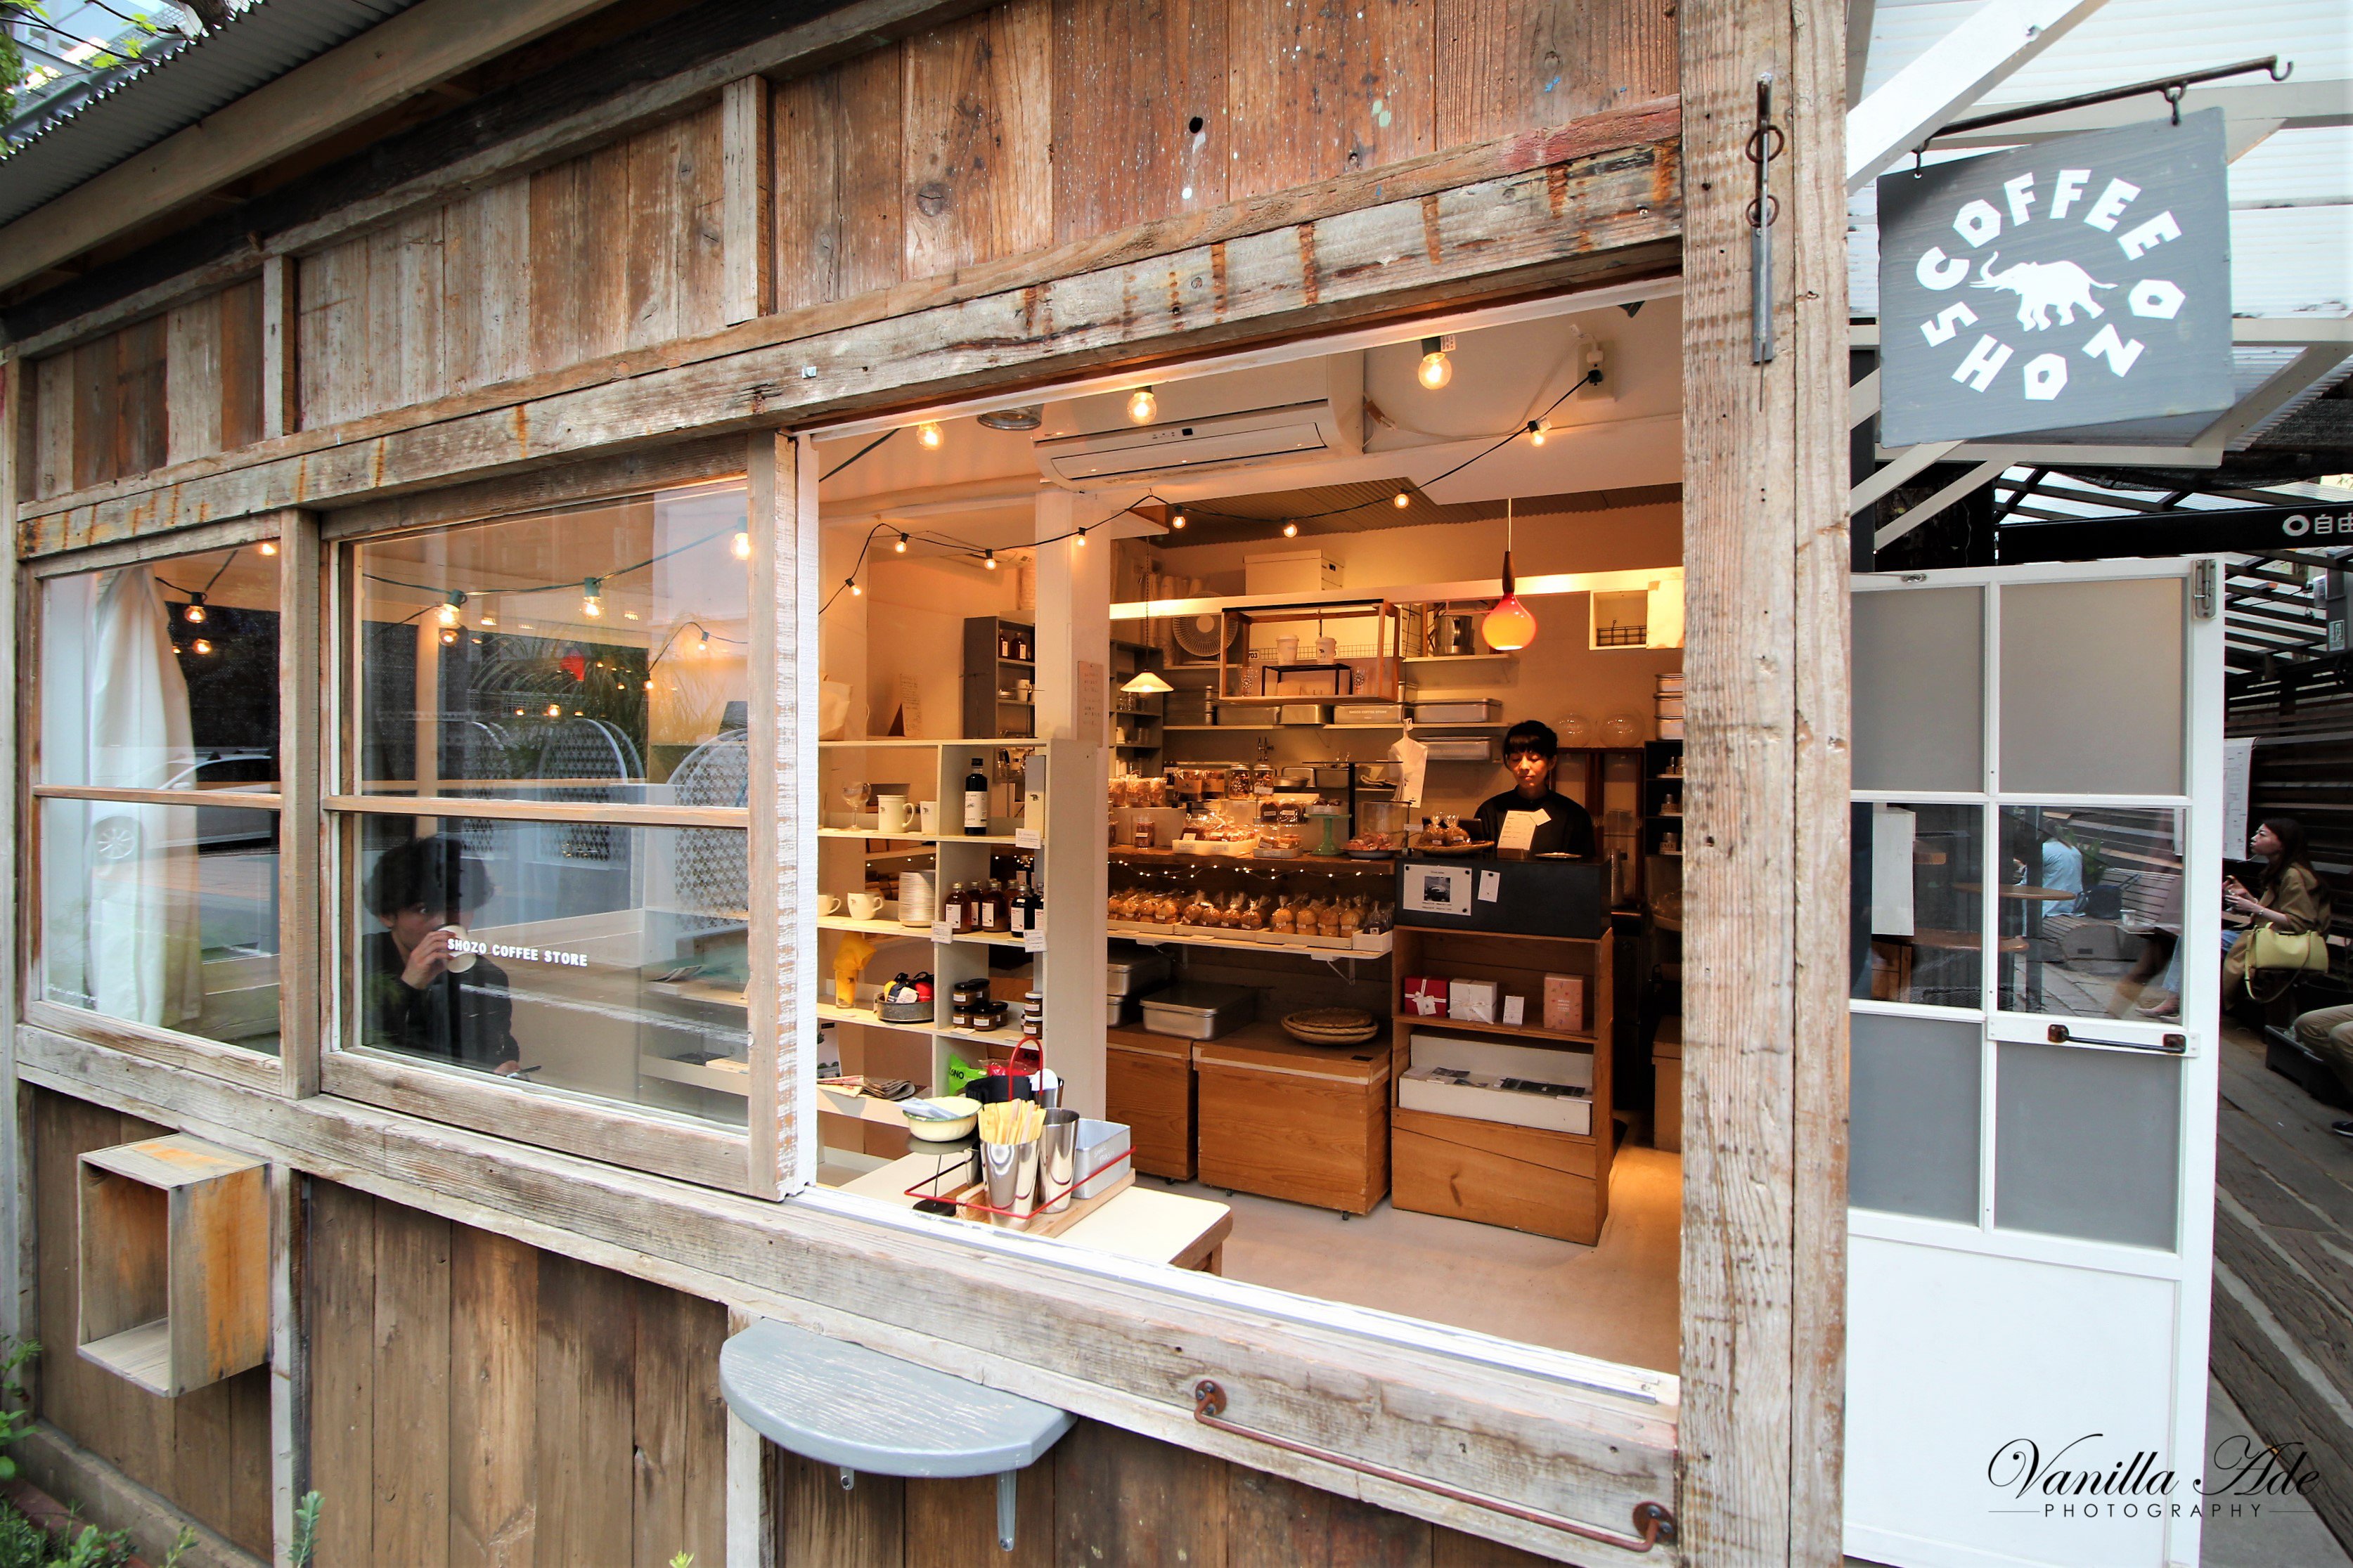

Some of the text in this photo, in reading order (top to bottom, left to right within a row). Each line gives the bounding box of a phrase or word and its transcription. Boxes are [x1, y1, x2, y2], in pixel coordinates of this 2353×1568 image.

[1916, 169, 2183, 291] COFFEE
[1919, 278, 2186, 401] SHOZO
[447, 938, 588, 967] SHOZO COFFEE STORE
